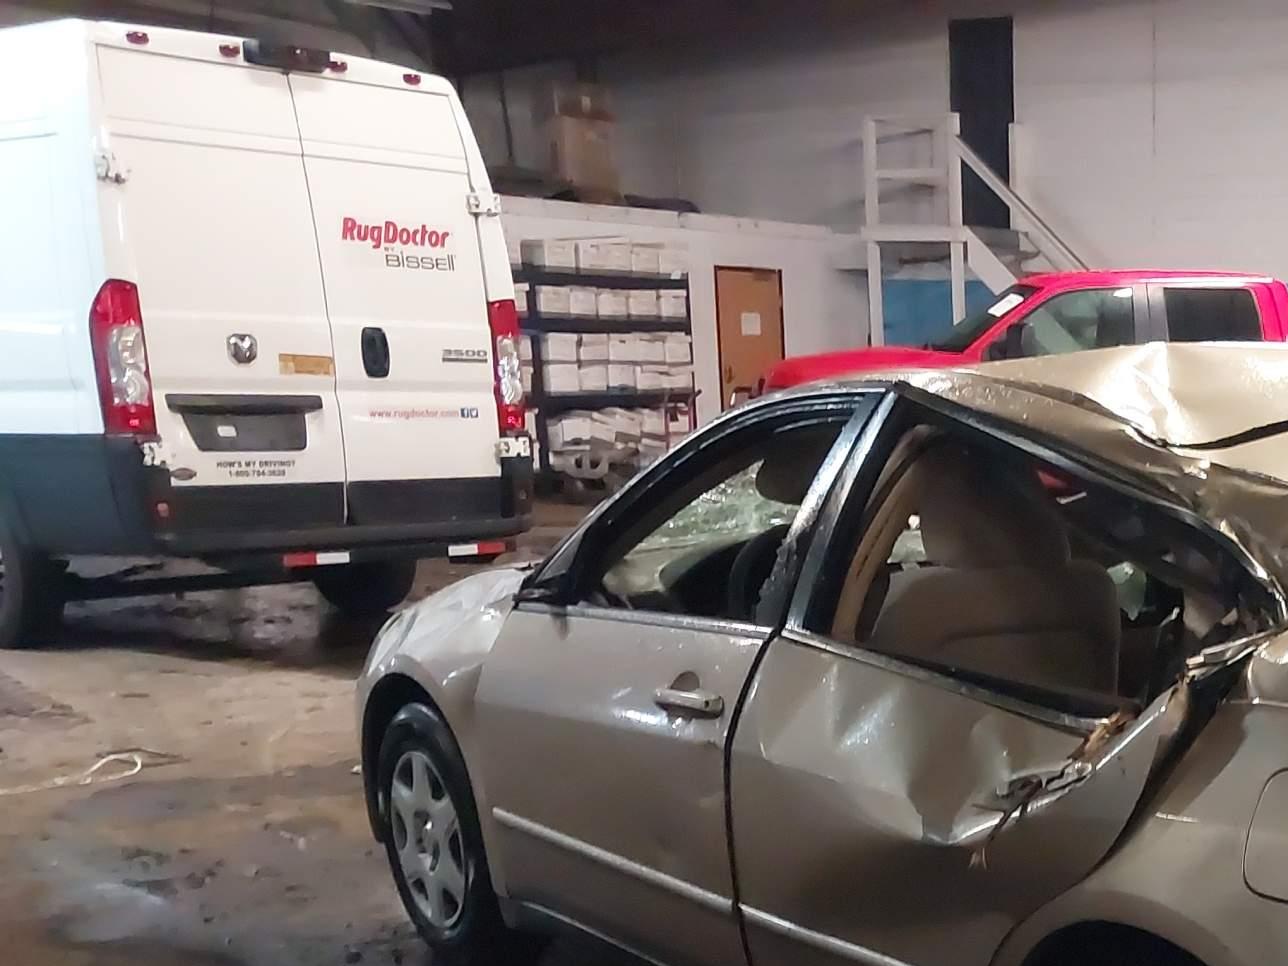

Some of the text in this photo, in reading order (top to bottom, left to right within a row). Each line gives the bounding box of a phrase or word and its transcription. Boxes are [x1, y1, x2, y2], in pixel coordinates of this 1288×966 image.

[368, 408, 460, 420] www.rugdoctor.com
[244, 460, 256, 468] MY
[259, 460, 295, 468] DRIVING?
